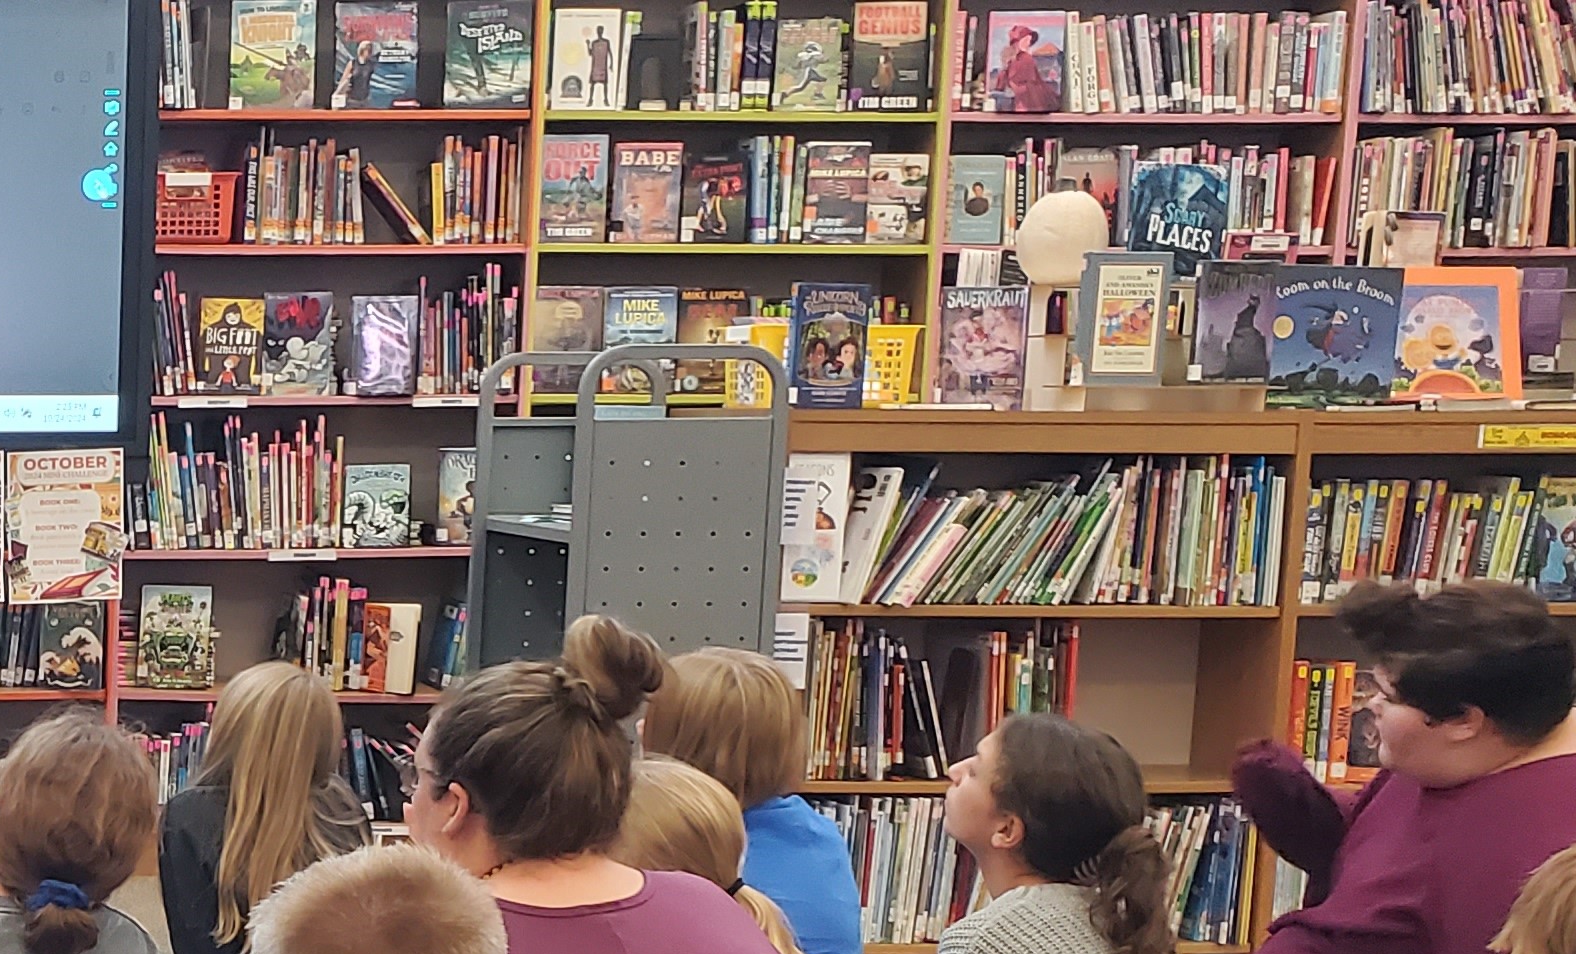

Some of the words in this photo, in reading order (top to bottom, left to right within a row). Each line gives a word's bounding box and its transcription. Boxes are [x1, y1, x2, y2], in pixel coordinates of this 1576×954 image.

[860, 5, 922, 18] FOOTBALL
[859, 19, 922, 35] GENIUS
[477, 29, 523, 53] ISLAND
[881, 96, 918, 109] GREEN
[545, 141, 601, 159] FORCE
[619, 150, 681, 167] BABE
[544, 159, 601, 181] OUT
[1164, 202, 1206, 226] SCARY
[1146, 213, 1213, 254] PLACES
[681, 290, 708, 300] MIKE
[709, 290, 745, 301] LUPICA
[811, 290, 861, 305] UNICORN
[946, 288, 1027, 309] SAUERKRAUT
[1102, 289, 1156, 297] HALLOWEEN
[1313, 279, 1330, 290] on
[1332, 277, 1352, 291] the
[1357, 279, 1395, 307] Broom
[622, 299, 661, 312] MIKE
[615, 312, 667, 326] LUPICA
[206, 327, 226, 344] BIG
[24, 456, 108, 471] OCTOBER
[63, 470, 108, 479] CHALLENGE
[1335, 706, 1351, 740] WINK
